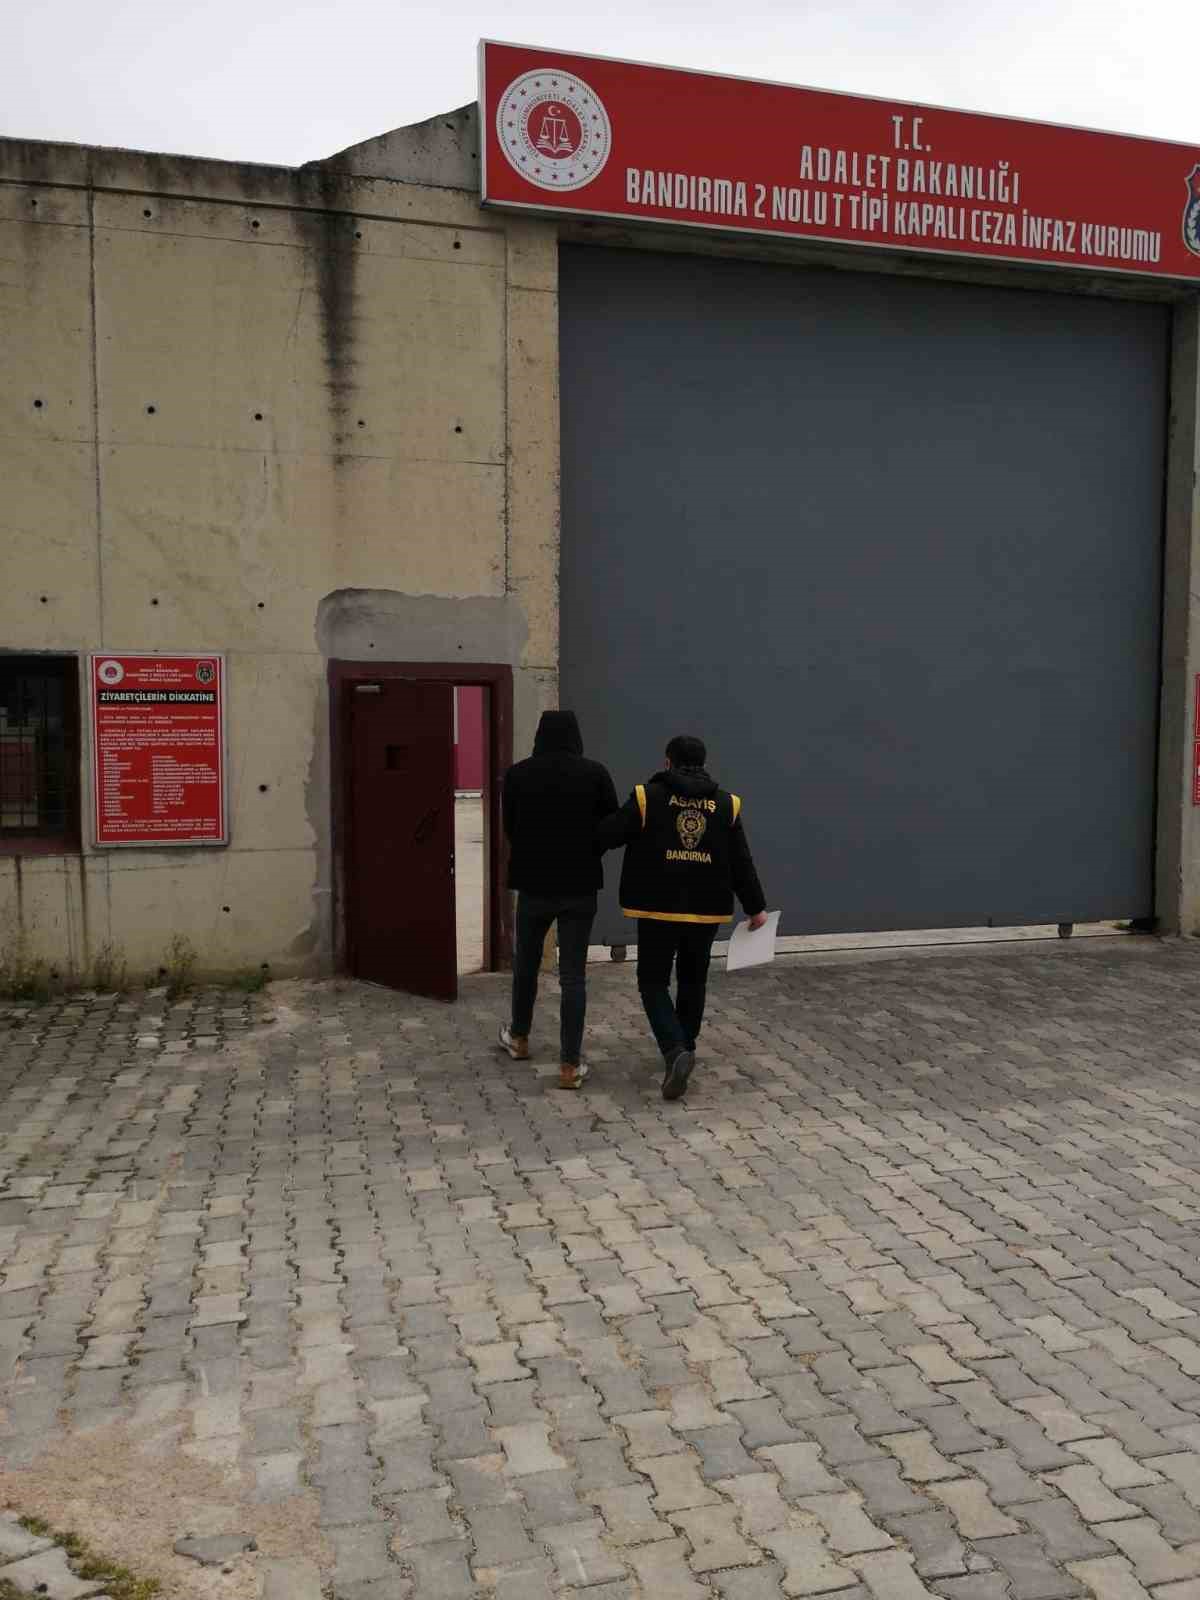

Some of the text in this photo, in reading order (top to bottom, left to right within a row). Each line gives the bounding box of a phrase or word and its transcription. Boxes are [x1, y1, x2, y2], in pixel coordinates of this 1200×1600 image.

[892, 115, 931, 151] T.C.
[800, 145, 1019, 204] ADALET BAKANLIĞI
[626, 167, 1161, 263] BANDIRMA 2 NOLU T TİPİ KAPALI CEZA İNFAZ KURUMU
[101, 691, 167, 702] ZİYARETÇİLERİN
[666, 849, 712, 864] BANDIRMA
